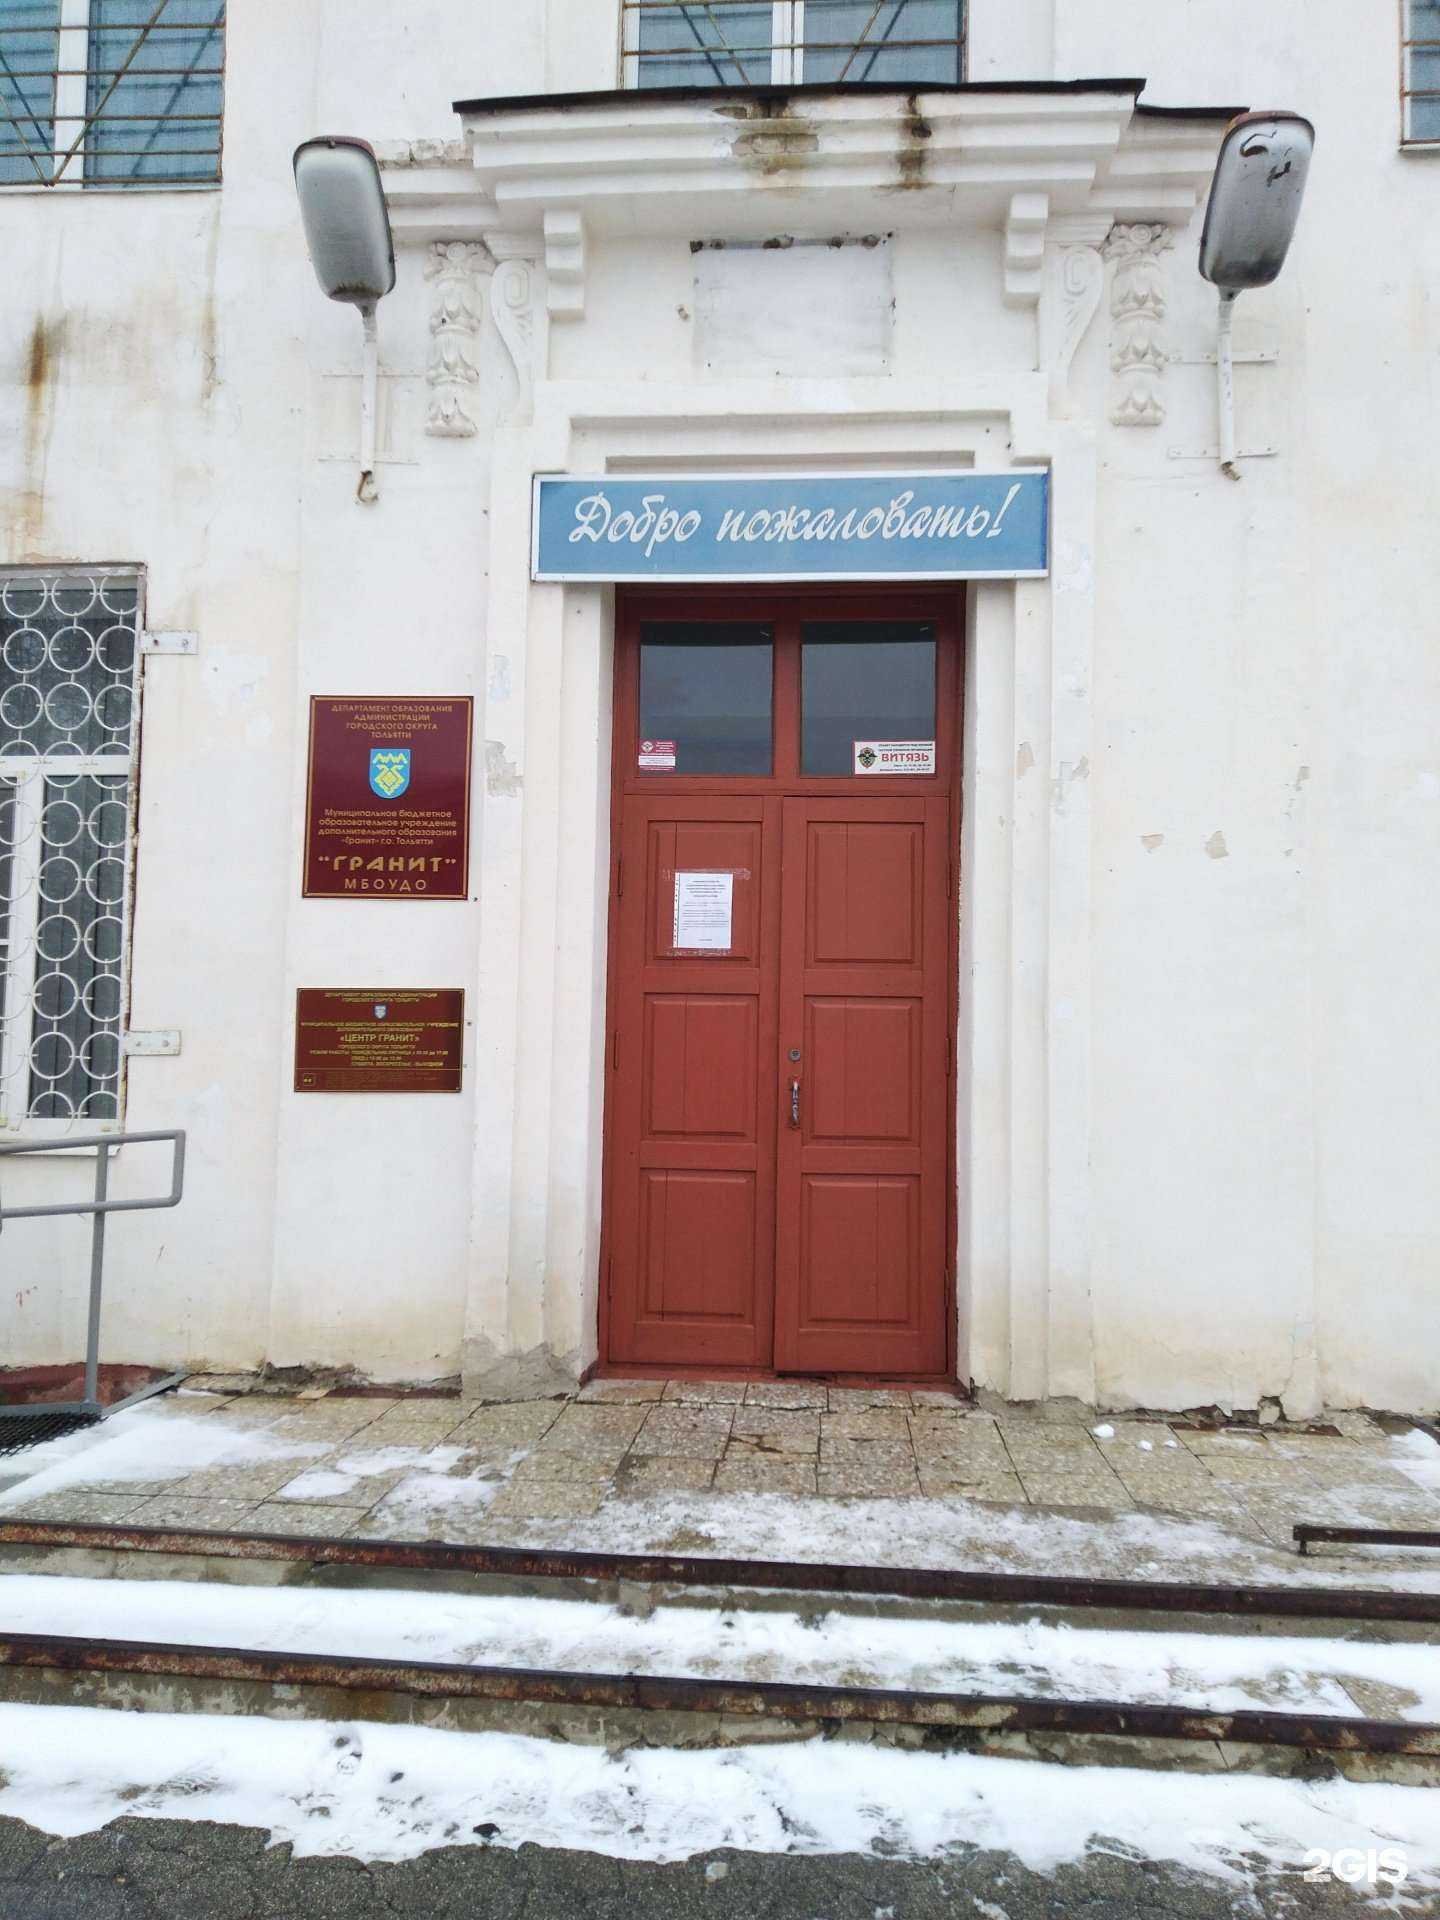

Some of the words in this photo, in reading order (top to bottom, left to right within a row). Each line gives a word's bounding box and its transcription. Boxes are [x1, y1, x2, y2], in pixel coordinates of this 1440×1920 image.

[568, 491, 701, 558] Добро
[716, 483, 1021, 543] пожаловать!
[391, 705, 453, 713] ОБРАЗОВАНИЯ
[881, 753, 929, 762] ВИТЯЗЬ
[324, 808, 397, 817] Муниципальное
[399, 809, 452, 818] бюджетное
[318, 818, 398, 827] образовательное
[400, 820, 457, 829] учреждение
[318, 828, 396, 837] дополнительного
[398, 828, 457, 837] образования
[396, 837, 434, 846] Тольятти
[344, 877, 427, 892] МБОУДО
